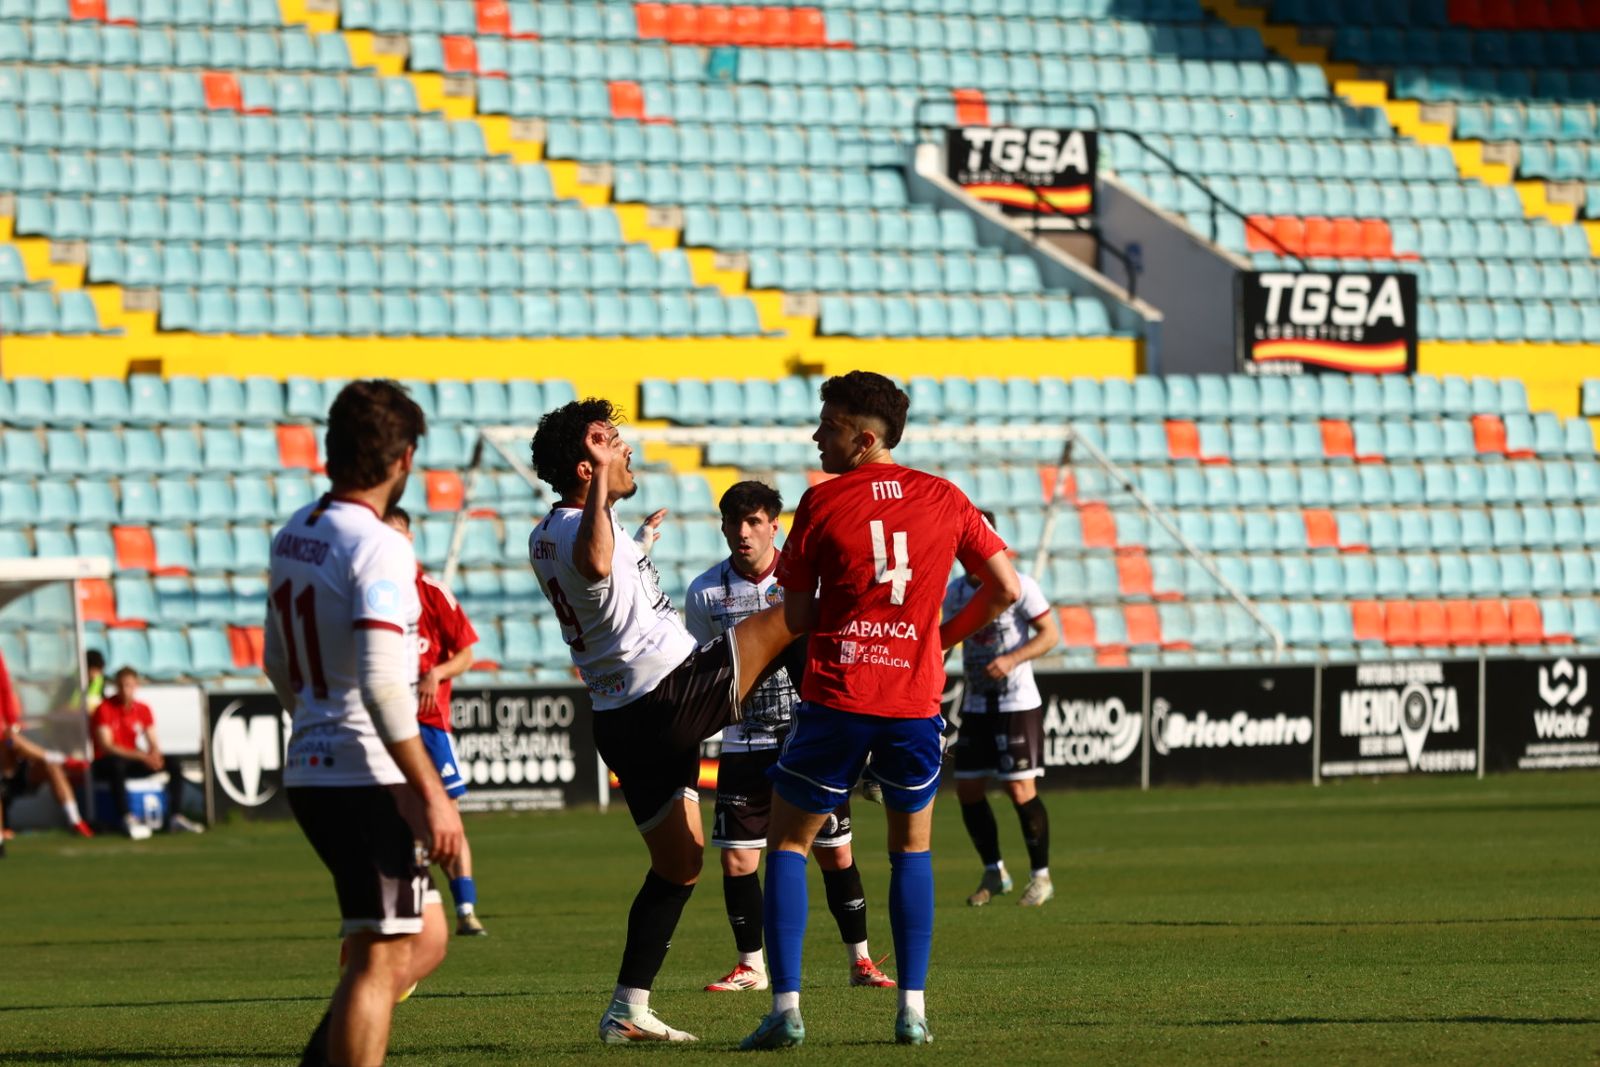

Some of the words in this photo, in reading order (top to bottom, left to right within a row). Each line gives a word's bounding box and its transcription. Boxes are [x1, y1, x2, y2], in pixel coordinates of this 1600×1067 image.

[962, 127, 1089, 175] TGSA
[1259, 273, 1405, 327] TGSA
[871, 480, 903, 501] FITO
[869, 520, 913, 605] 4
[273, 578, 329, 700] 11
[843, 620, 918, 641] ABANCA
[857, 643, 890, 656] XNTA
[870, 655, 911, 670] GALICIA
[1043, 694, 1127, 735] ÁXIMO
[1164, 709, 1313, 749] BricoCentro
[1339, 685, 1460, 738] MENDOZA
[1043, 733, 1115, 766] LECOM
